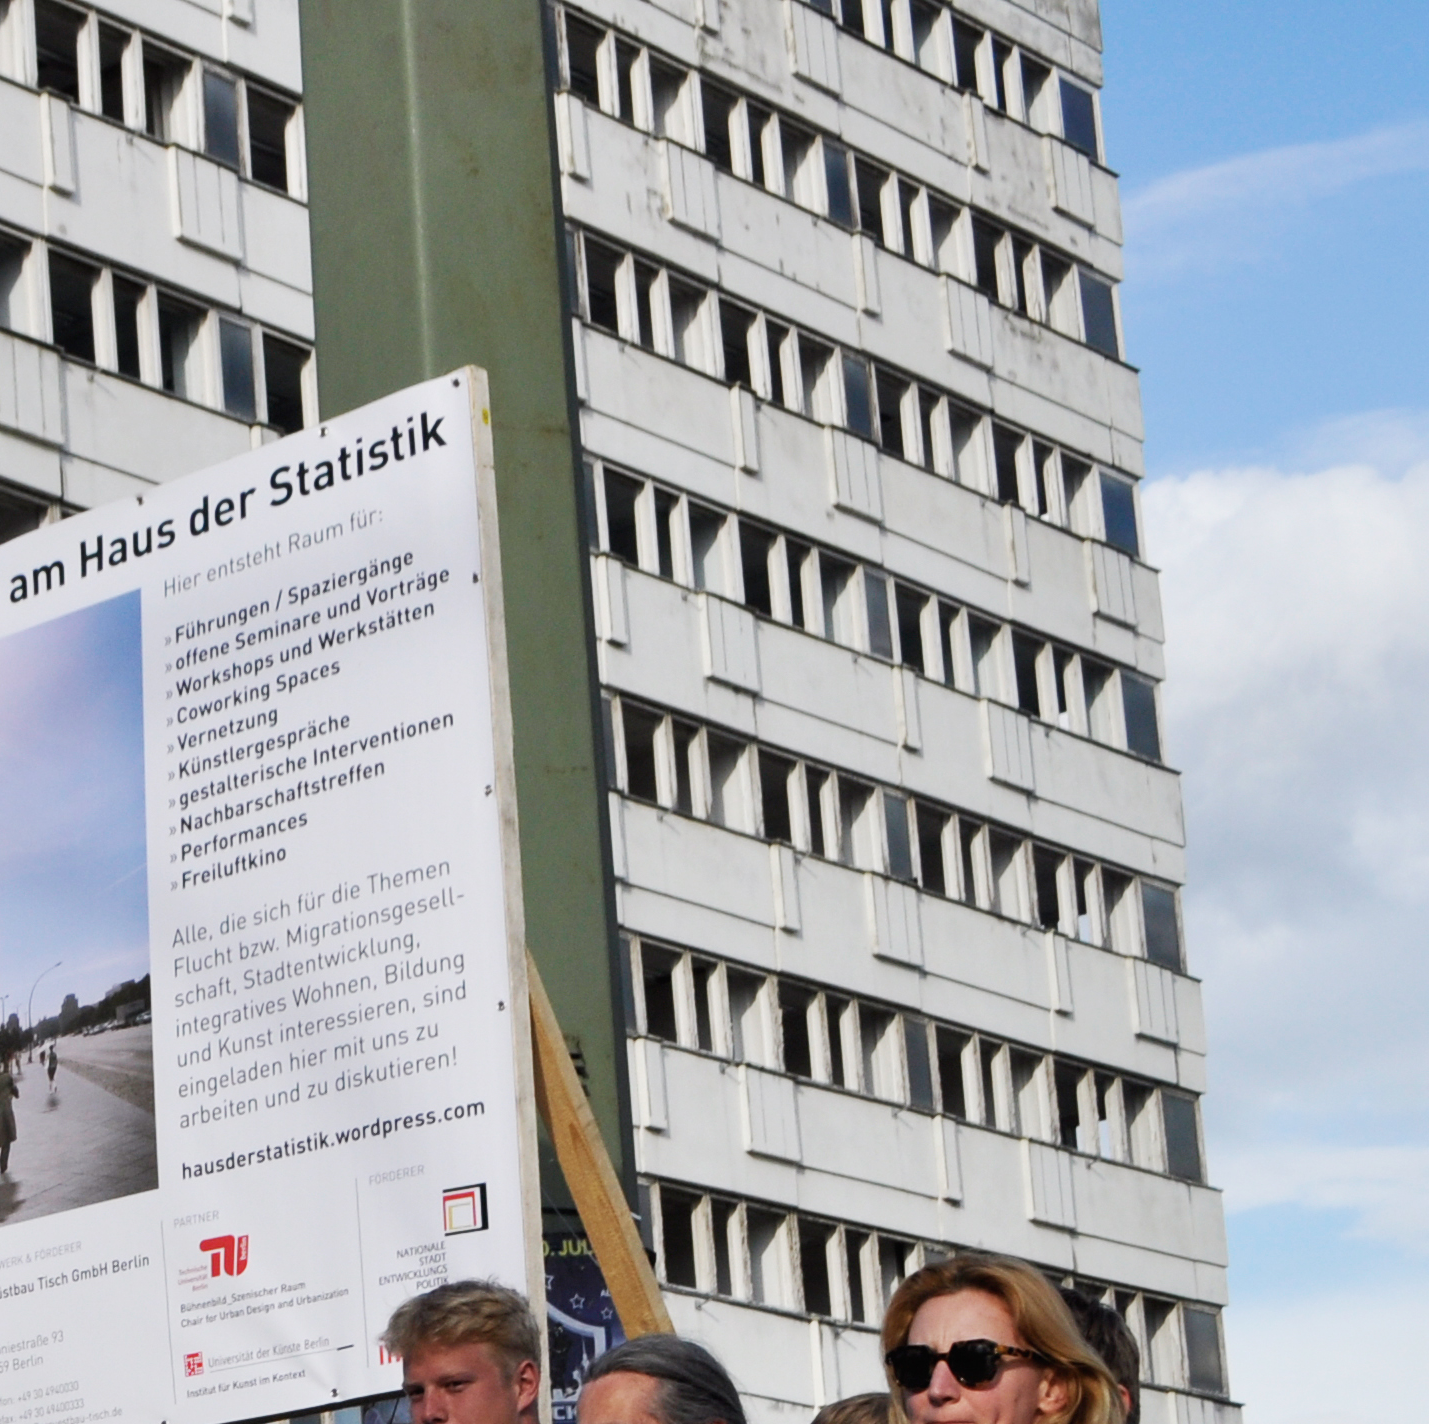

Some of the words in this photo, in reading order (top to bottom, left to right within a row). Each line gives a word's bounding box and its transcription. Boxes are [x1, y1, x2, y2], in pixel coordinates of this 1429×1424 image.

[9, 560, 65, 603] am
[79, 519, 177, 579] Haus
[190, 487, 257, 537] der
[269, 411, 448, 507] Statistik
[163, 571, 200, 598] Hier
[206, 541, 282, 583] entsteht
[288, 519, 344, 555] Raum
[348, 506, 384, 533] für:
[174, 639, 230, 672] offene
[235, 610, 321, 650] Seminare
[327, 594, 362, 620] und
[366, 567, 451, 608] Vorträge
[175, 599, 271, 645] Führungen
[275, 590, 283, 611] /
[287, 551, 415, 613] Spaziergänge
[175, 654, 275, 698] Workshops
[279, 637, 313, 663] und
[318, 602, 436, 650] Werkstätten
[177, 681, 271, 726] Coworking
[276, 660, 341, 694] Spaces
[177, 707, 279, 751] Vernetzung
[178, 714, 351, 780] Künstlergespräche
[179, 754, 308, 811] gestalterische
[312, 712, 455, 766] Interventionen
[180, 761, 387, 835] Nachbarschaftstreffen
[181, 812, 309, 862] Performances
[181, 847, 287, 890] Freiluftkino
[172, 922, 214, 948] Alle,
[219, 912, 248, 936] die
[253, 899, 292, 928] sich
[297, 891, 327, 915] für
[332, 881, 362, 905] die
[367, 860, 451, 894] Themen
[173, 947, 234, 979] Flucht
[238, 936, 281, 962] bzw.
[286, 886, 466, 948] Migrationsgesell-
[175, 977, 239, 1008] schaft,
[243, 931, 422, 991] Stadtentwicklung,
[176, 995, 288, 1039] integratives
[292, 975, 379, 1009] Wohnen,
[384, 951, 466, 985] Bildung
[177, 1046, 213, 1068] und
[218, 1031, 274, 1058] Kunst
[279, 998, 417, 1042] interessieren,
[422, 979, 468, 1009] sind
[178, 1058, 284, 1099] eingeladen
[289, 1047, 328, 1072] hier
[333, 1036, 366, 1062] mit
[371, 1027, 410, 1052] uns
[414, 1021, 440, 1042] zu
[179, 1096, 259, 1130] arbeiten
[264, 1083, 302, 1110] und
[306, 1080, 329, 1101] zu
[334, 1045, 458, 1094] diskutieren!
[181, 1098, 487, 1182] hausderstatistik.wordpress.com
[172, 1210, 221, 1229] PARTNER
[396, 1240, 446, 1259] NATIONALE
[37, 1272, 69, 1291] Tisch
[71, 1263, 109, 1283] GmbH
[112, 1254, 150, 1274] Berlin
[281, 1281, 306, 1293] Raum
[378, 1264, 448, 1286] ENTWICKLUNGS
[419, 1252, 447, 1267] STADT
[51, 1330, 64, 1344] 93
[181, 1317, 204, 1328] Chair
[205, 1314, 218, 1323] for
[219, 1308, 245, 1321] Urban
[246, 1301, 275, 1315] Design
[277, 1298, 294, 1310] and
[296, 1288, 349, 1307] Urbanization
[12, 1354, 44, 1372] Berlin
[186, 1385, 217, 1399] Institut
[218, 1382, 231, 1393] für
[232, 1377, 258, 1390] Kunst
[259, 1376, 270, 1385] im
[272, 1368, 306, 1383] Kontext
[207, 1350, 254, 1368] Universität
[256, 1348, 270, 1360] der
[272, 1341, 302, 1356] Künste
[304, 1336, 330, 1350] Berlin
